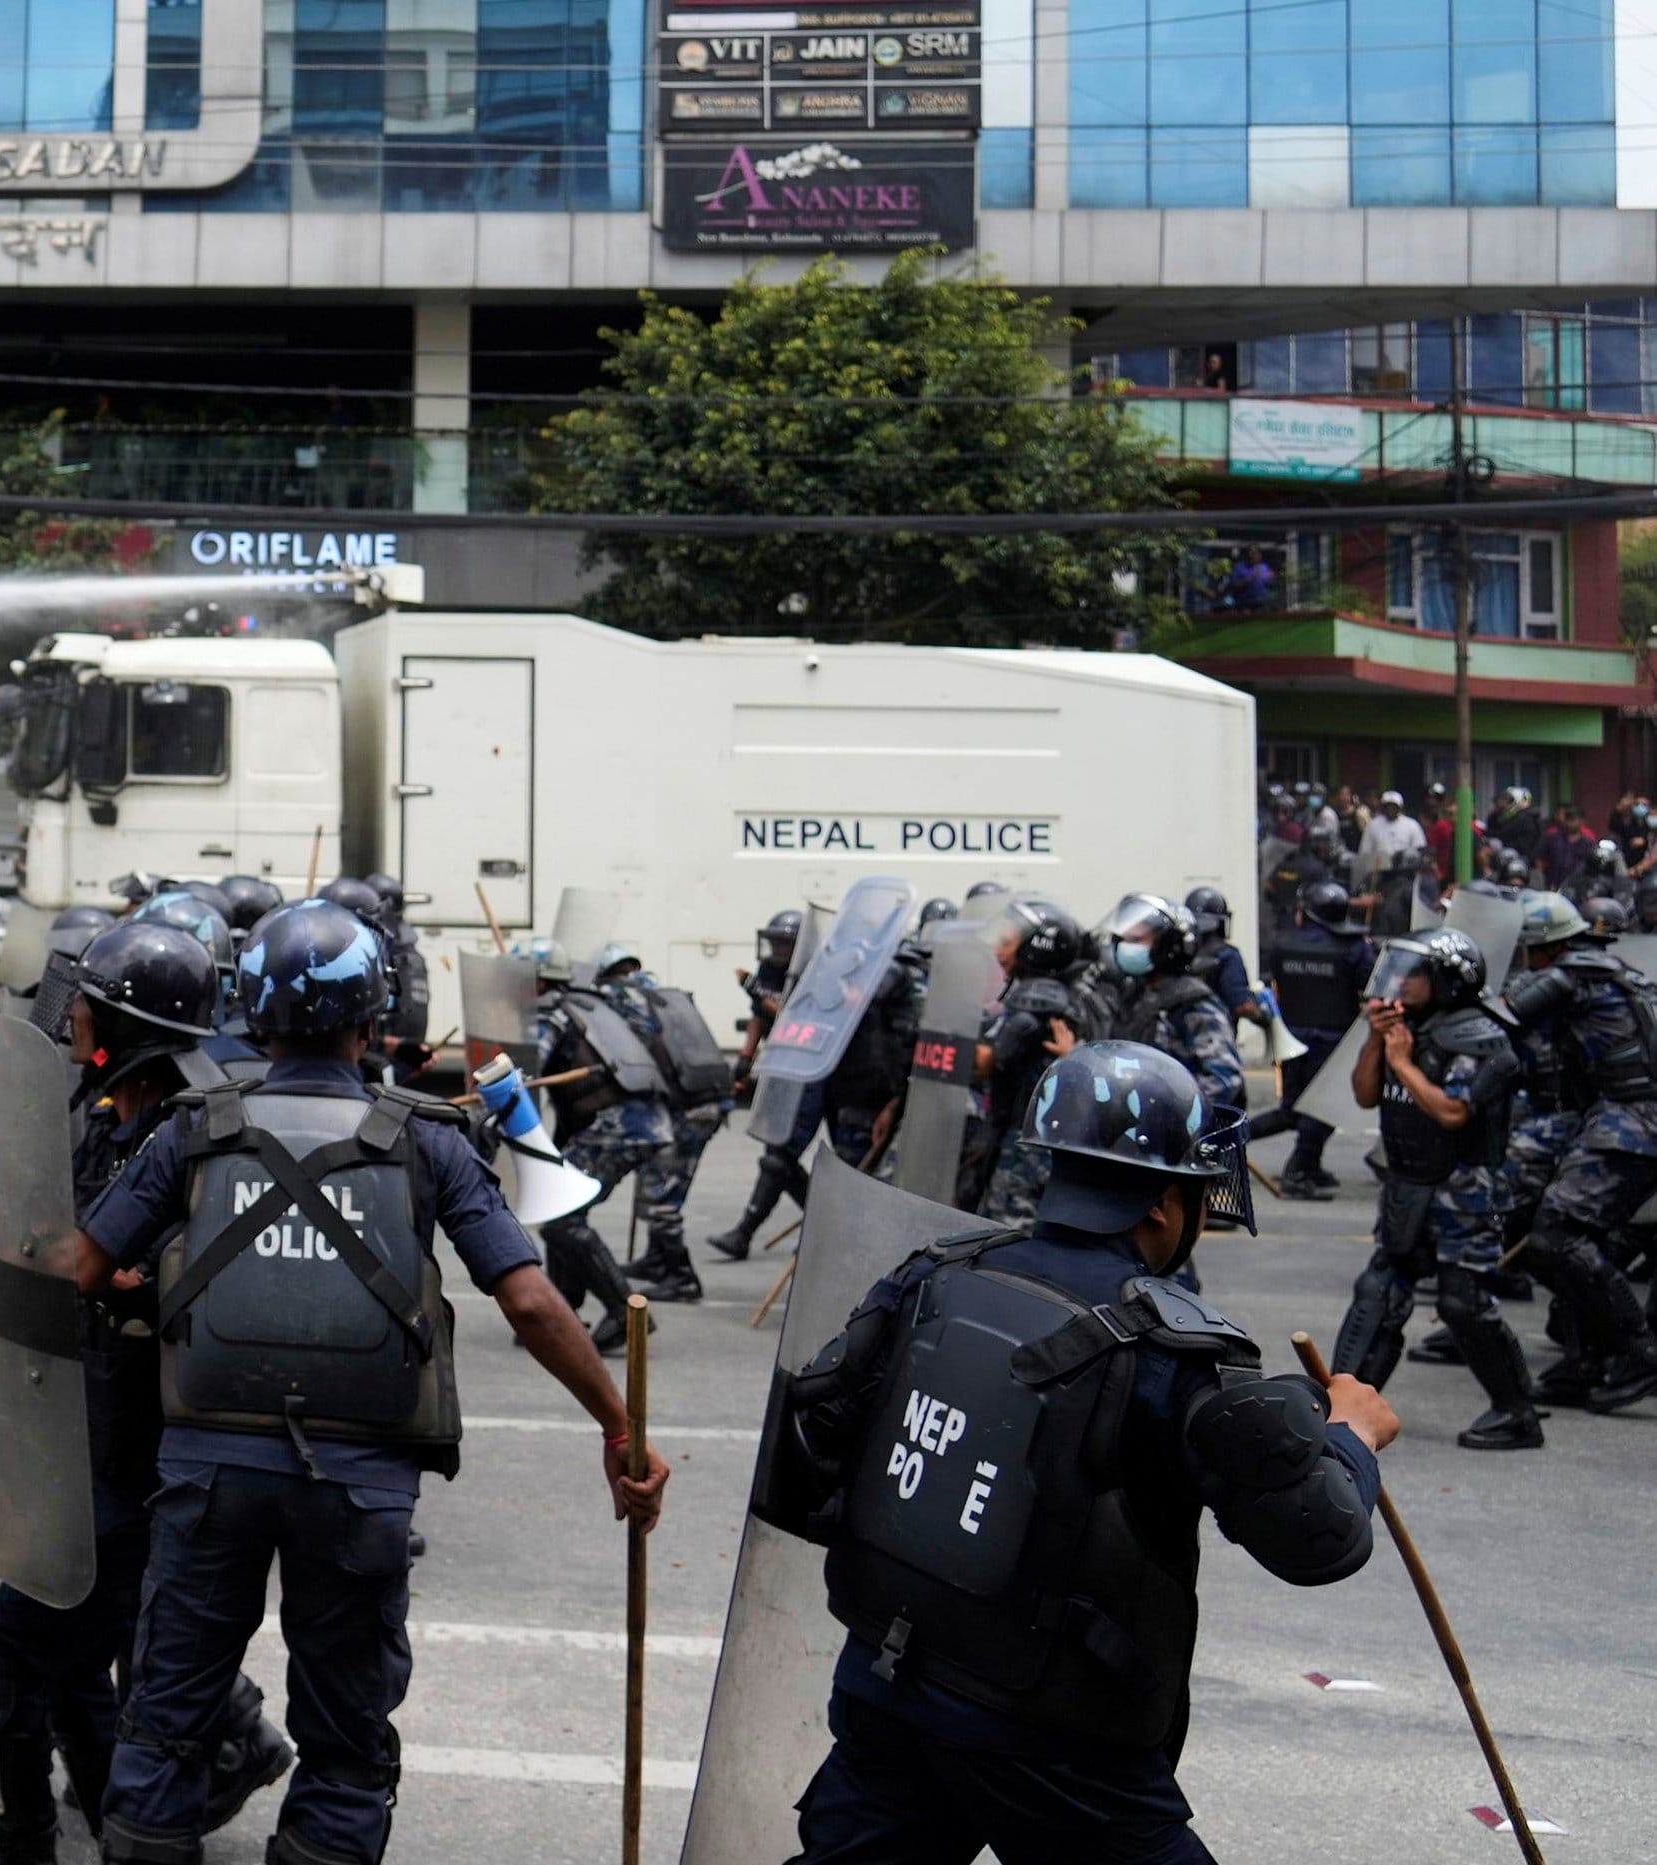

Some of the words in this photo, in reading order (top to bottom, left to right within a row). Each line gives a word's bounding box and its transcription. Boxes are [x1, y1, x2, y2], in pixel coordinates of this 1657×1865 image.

[710, 38, 760, 60] VIT
[799, 37, 866, 59] JAIN
[906, 32, 969, 57] SRM
[703, 145, 921, 211] ANANEKE
[190, 530, 397, 566] ORIFLAME
[743, 820, 875, 849] NEPAL
[902, 821, 1051, 852] POLICE
[254, 1223, 364, 1261] OLIC
